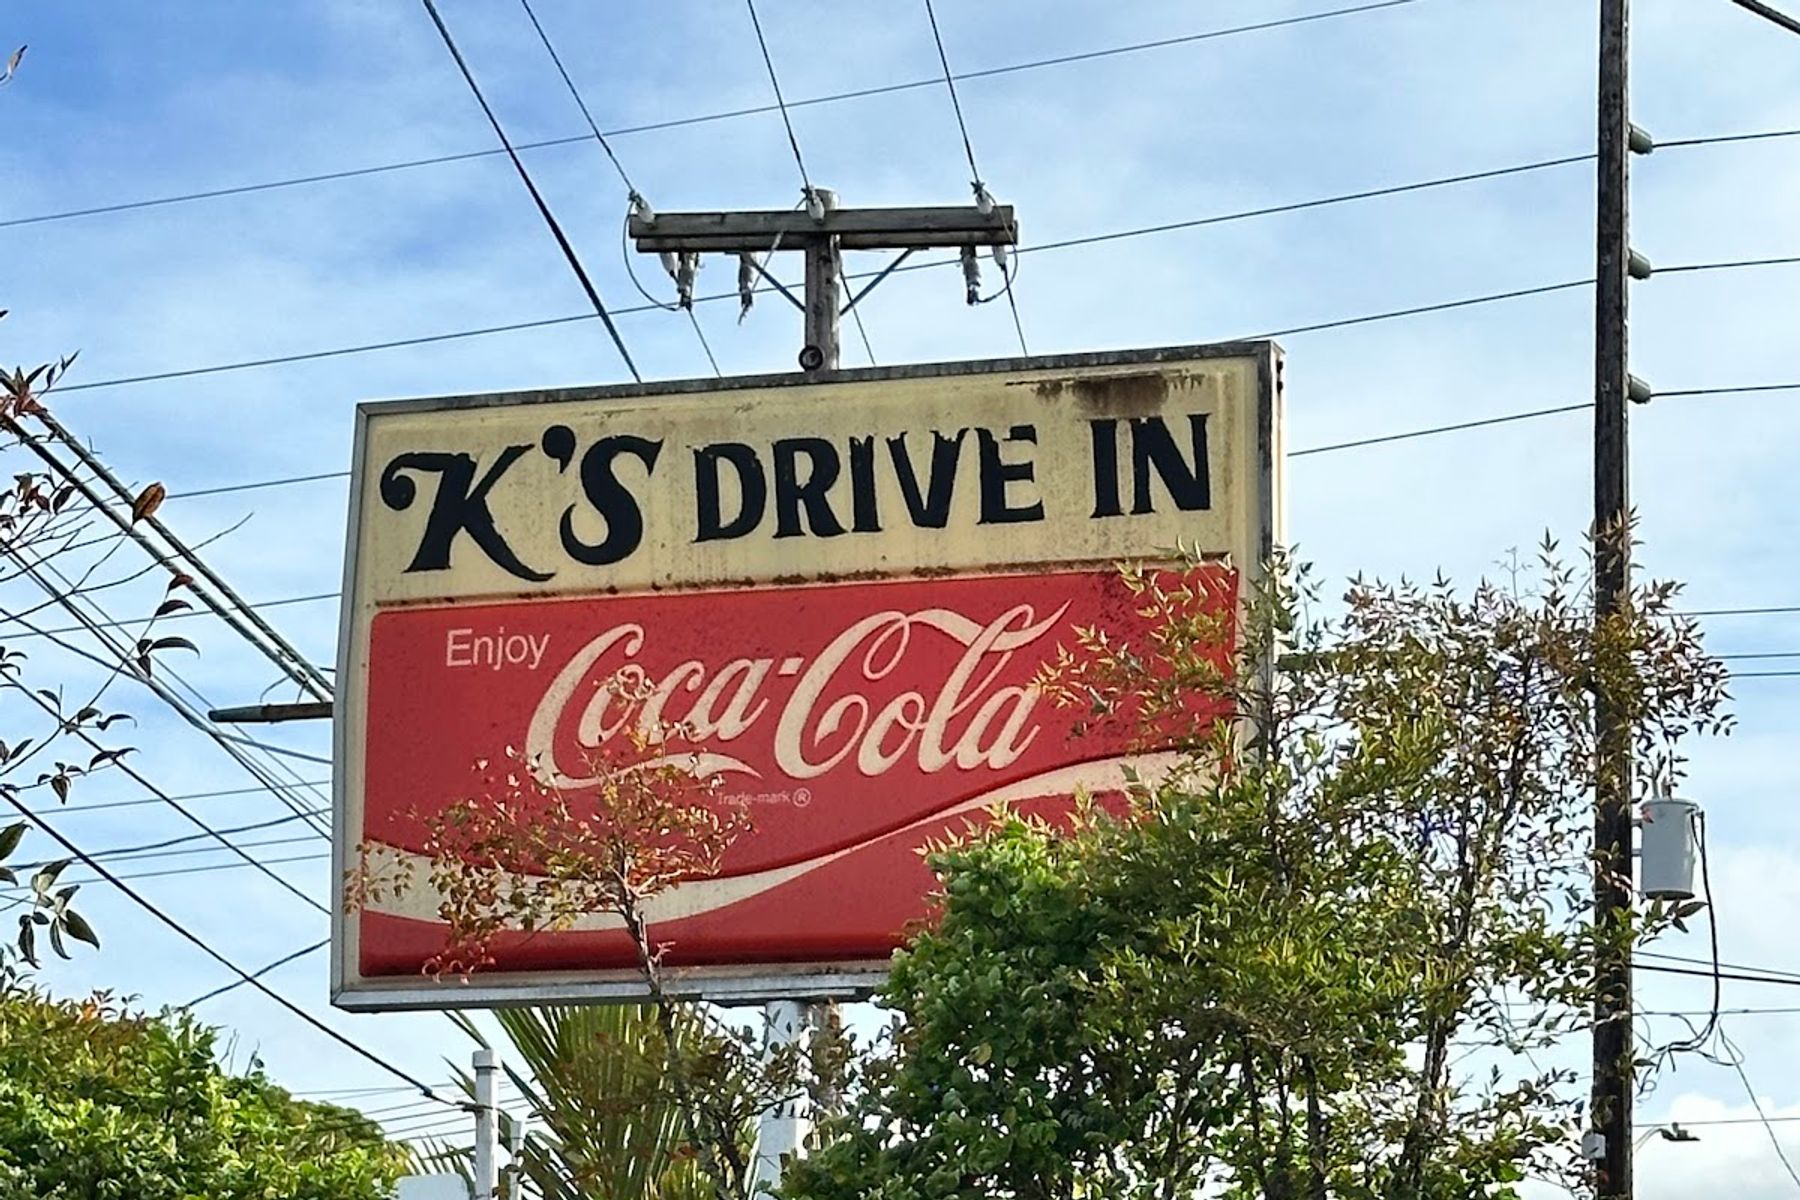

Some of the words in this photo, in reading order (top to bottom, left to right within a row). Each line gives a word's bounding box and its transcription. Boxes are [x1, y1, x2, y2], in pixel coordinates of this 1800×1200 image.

[379, 424, 665, 582] K'S
[689, 424, 1045, 543] DRIVE
[1089, 412, 1213, 519] IN
[446, 627, 551, 671] Enjoy
[525, 599, 1073, 790] Coca-Cola
